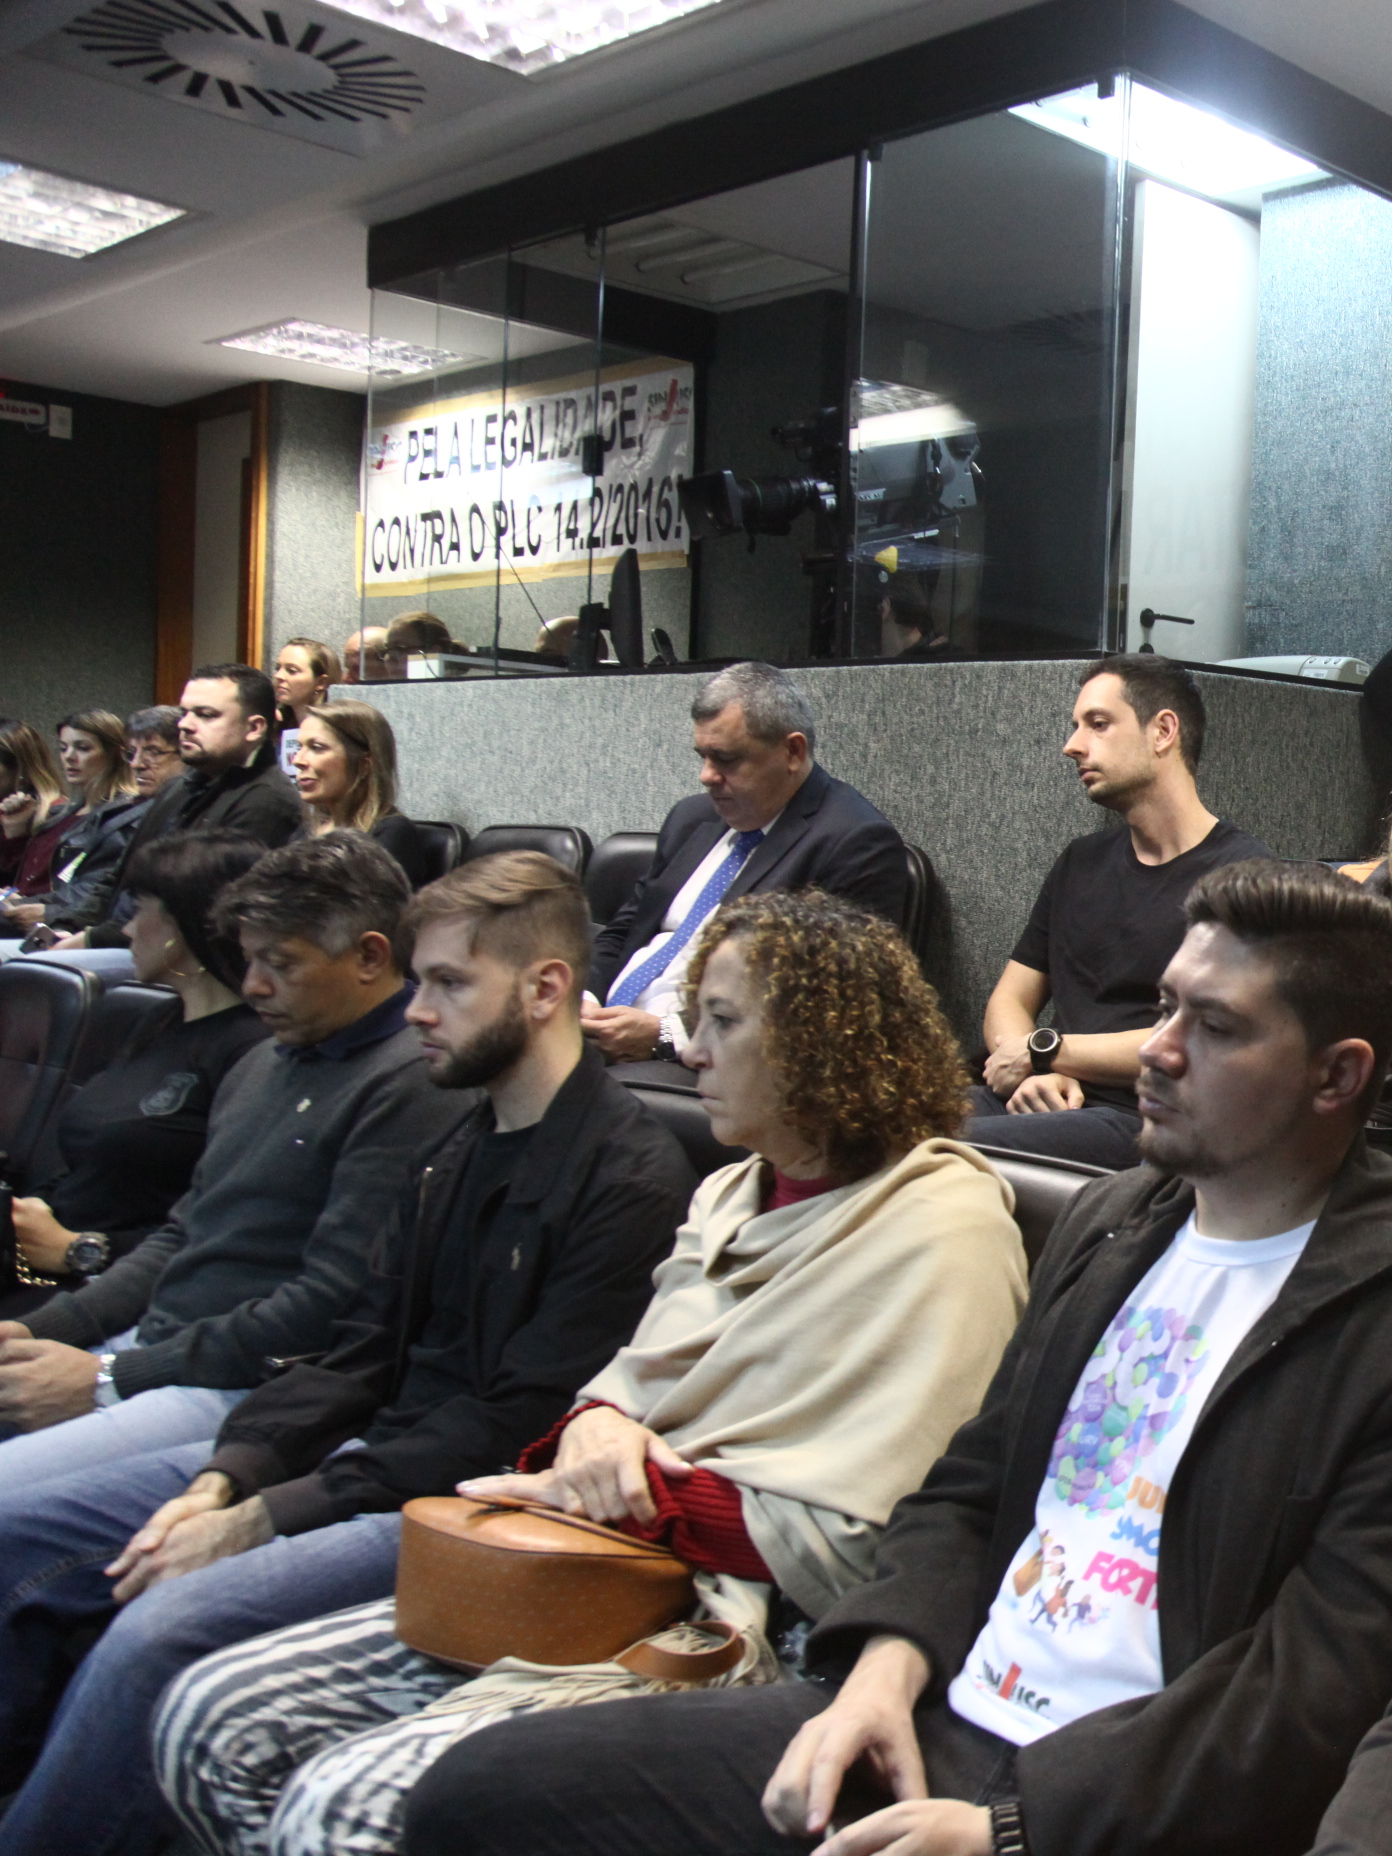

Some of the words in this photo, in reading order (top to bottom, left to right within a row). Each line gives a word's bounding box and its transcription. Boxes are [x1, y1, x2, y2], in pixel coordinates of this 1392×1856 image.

[404, 421, 461, 485] PELA
[372, 507, 460, 574] CONTRA
[469, 502, 485, 562] O
[493, 494, 543, 560] PLC
[1082, 1550, 1160, 1610] FORT
